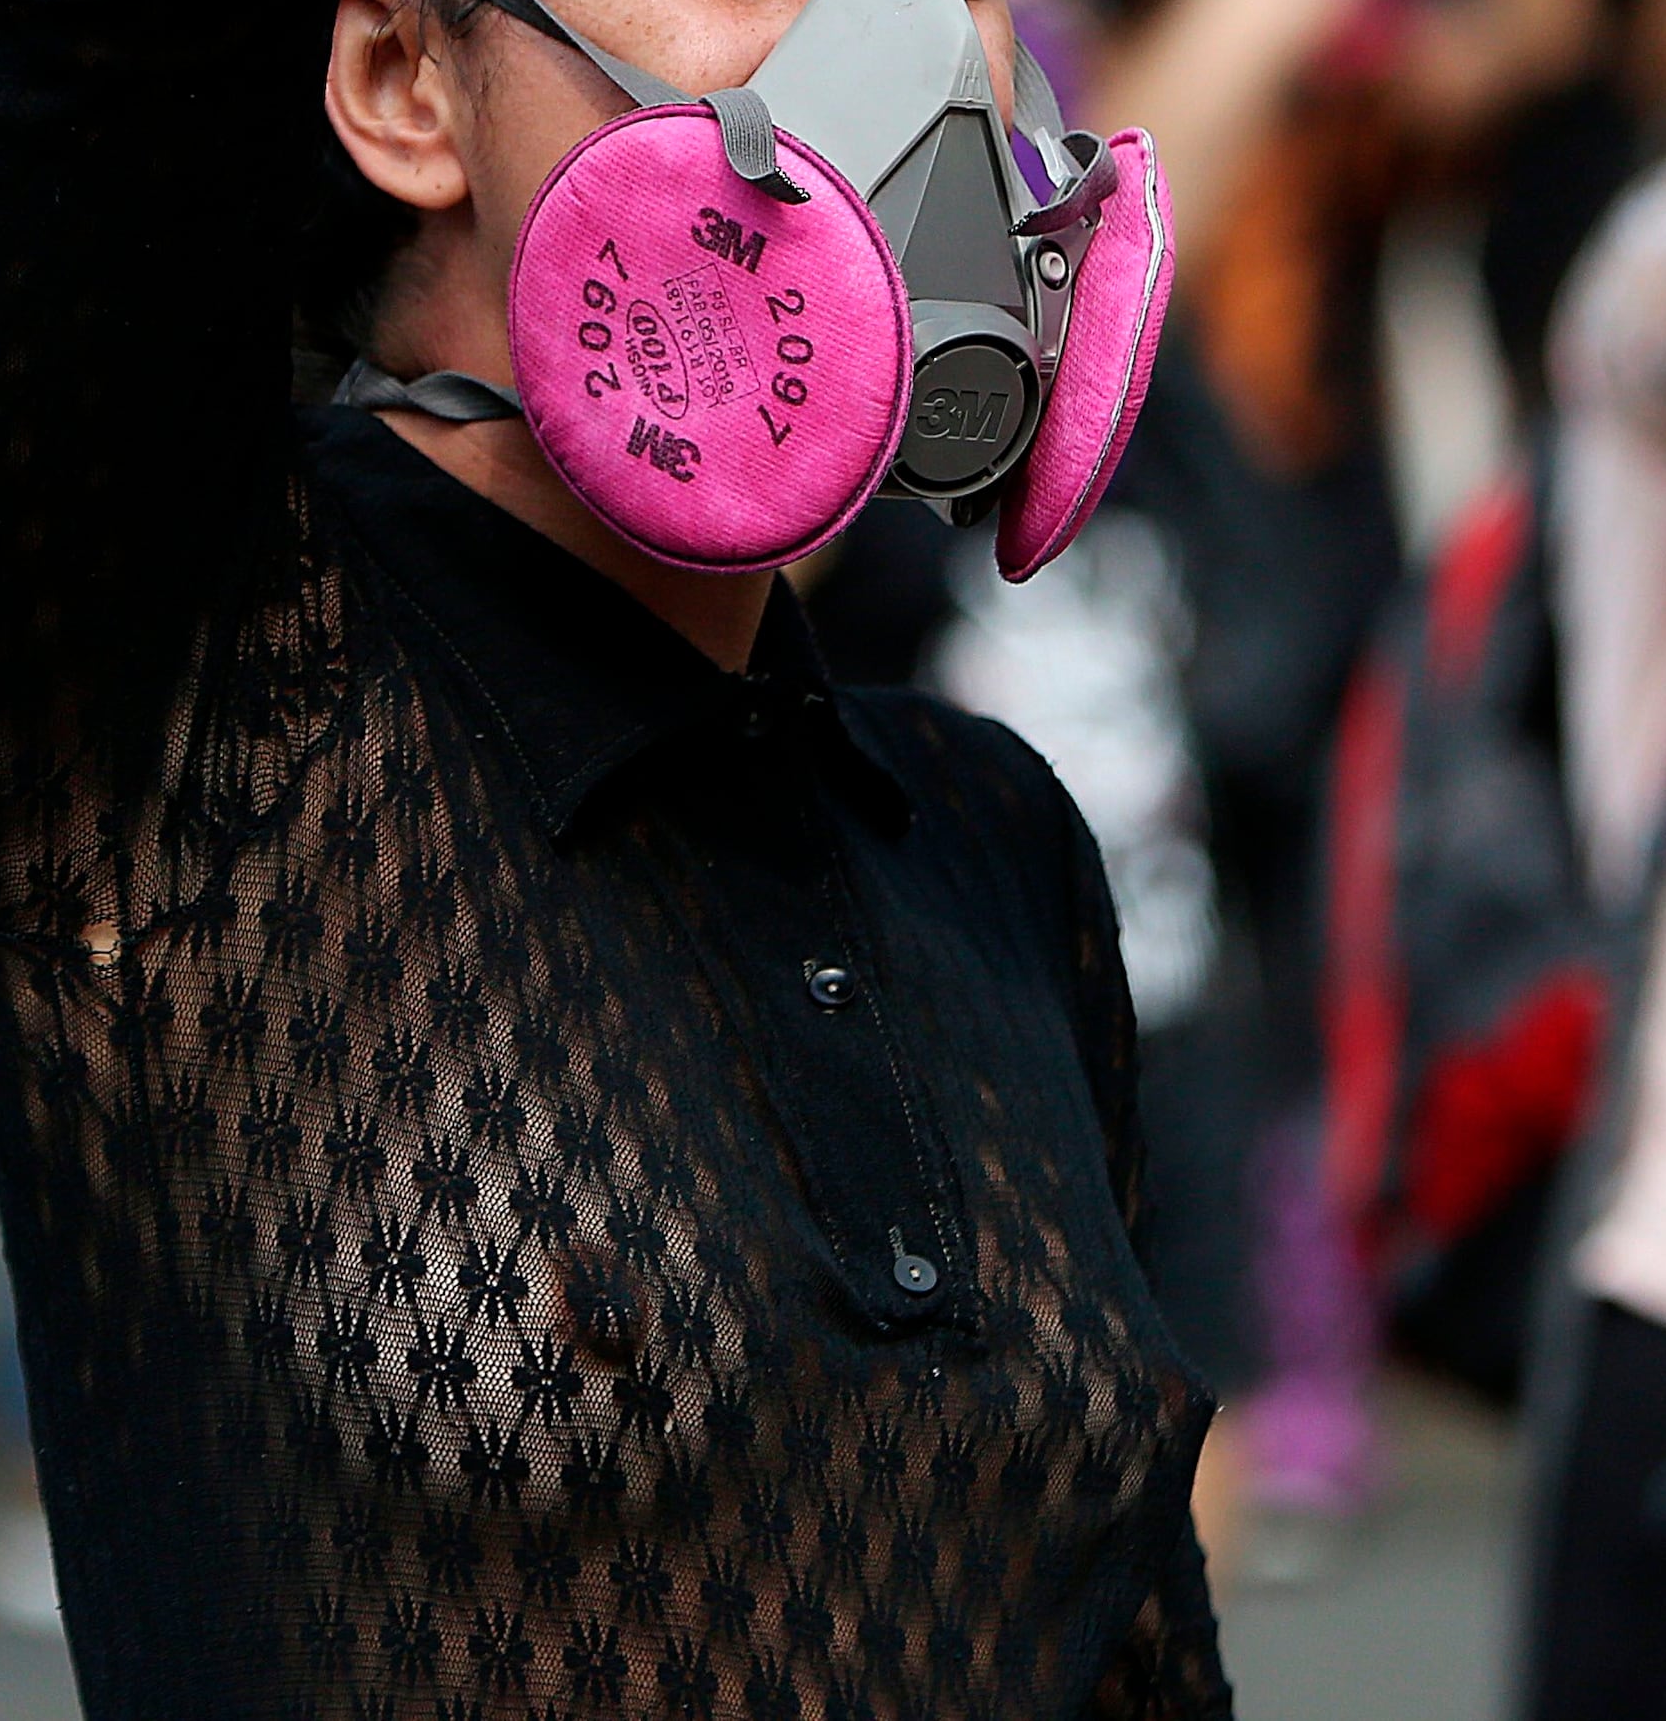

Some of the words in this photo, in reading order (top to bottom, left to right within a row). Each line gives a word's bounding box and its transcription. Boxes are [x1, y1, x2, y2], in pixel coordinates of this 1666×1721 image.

[690, 207, 766, 274] 3M
[579, 239, 629, 400] 2097
[662, 279, 705, 369] R191481
[685, 280, 707, 311] FAB
[698, 317, 734, 395] 05/2019
[625, 338, 653, 396] NIOSH
[632, 316, 685, 403] P100
[697, 376, 719, 408] LOT
[757, 289, 814, 446] 2097
[625, 415, 703, 482] 3M
[917, 387, 1009, 444] 3M
